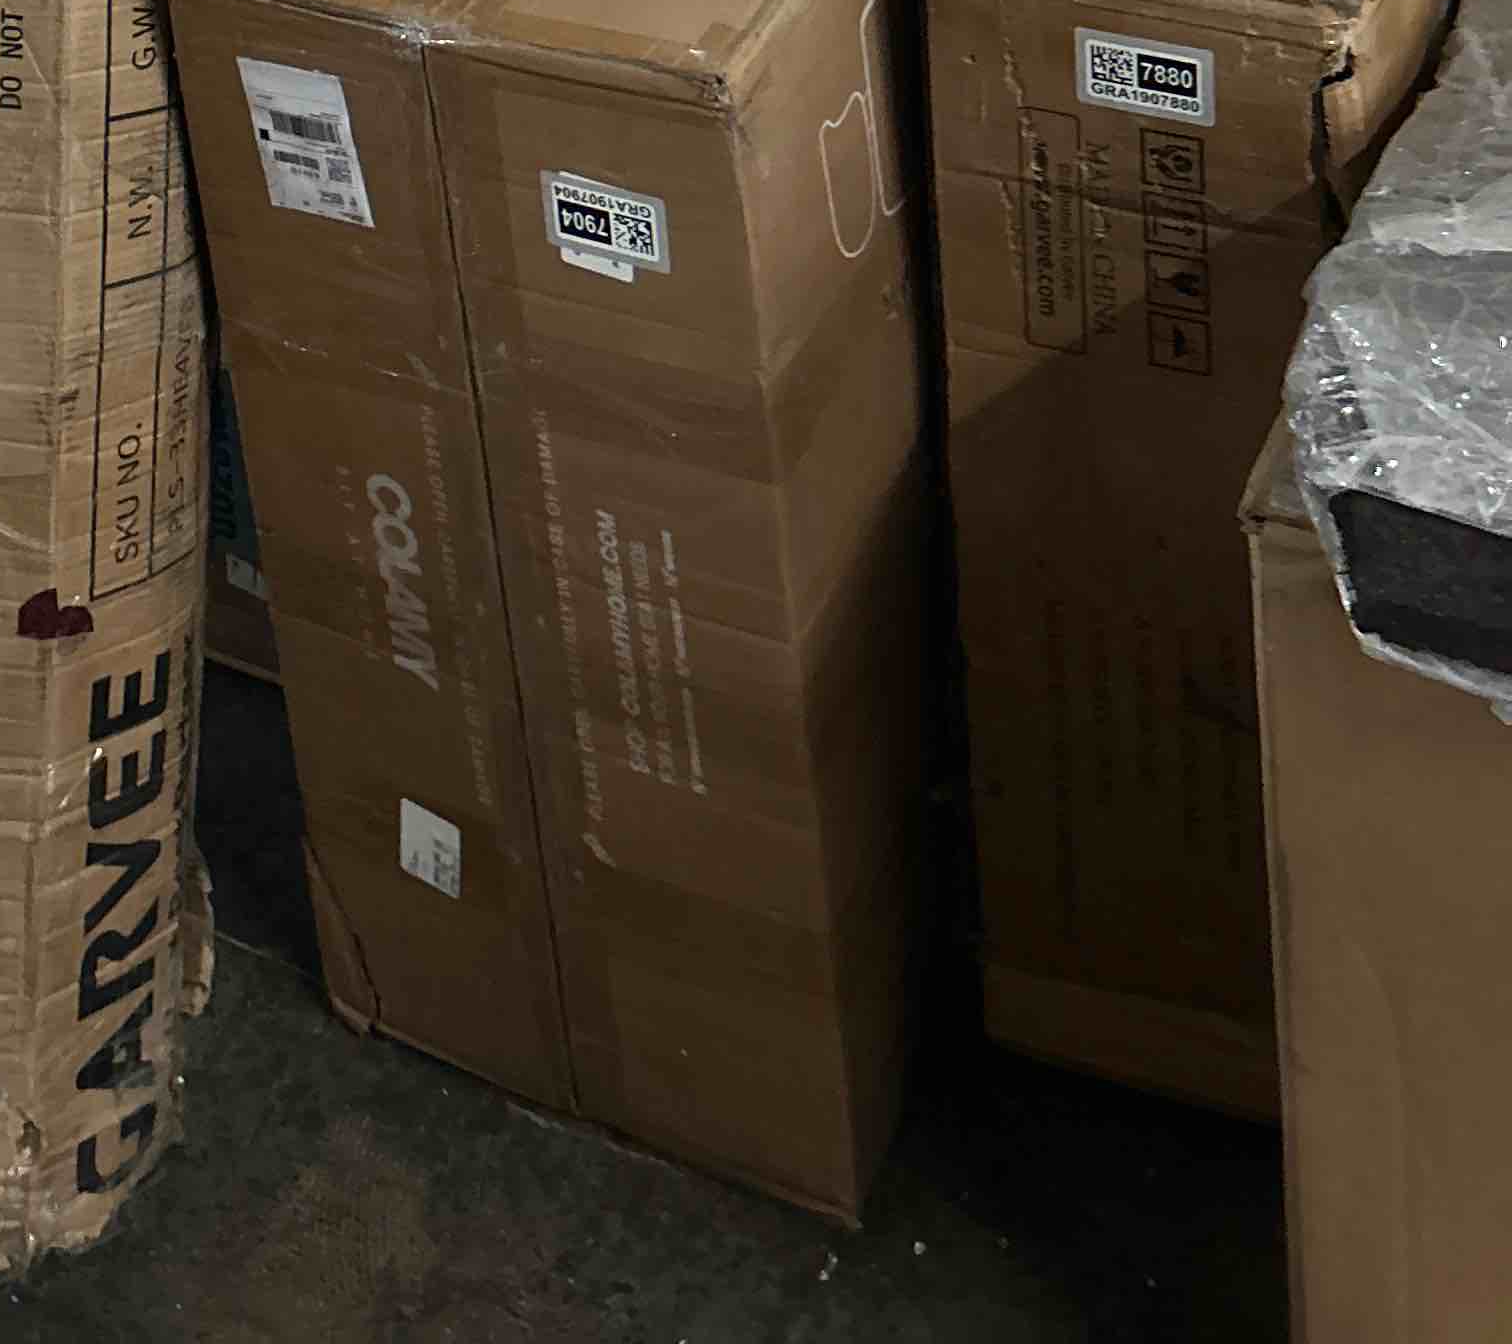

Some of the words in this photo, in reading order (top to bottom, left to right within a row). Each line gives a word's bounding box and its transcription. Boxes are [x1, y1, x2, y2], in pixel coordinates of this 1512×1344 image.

[1090, 81, 1200, 112] GRA1907880
[1139, 61, 1193, 88] 7880
[127, 163, 154, 238] N.W.
[552, 181, 652, 219] GRA1907904
[559, 205, 610, 238] 7904
[117, 421, 143, 486] NO.
[114, 494, 140, 562] SKU
[366, 472, 437, 691] COLAMY
[76, 648, 171, 1196] GARVEE
